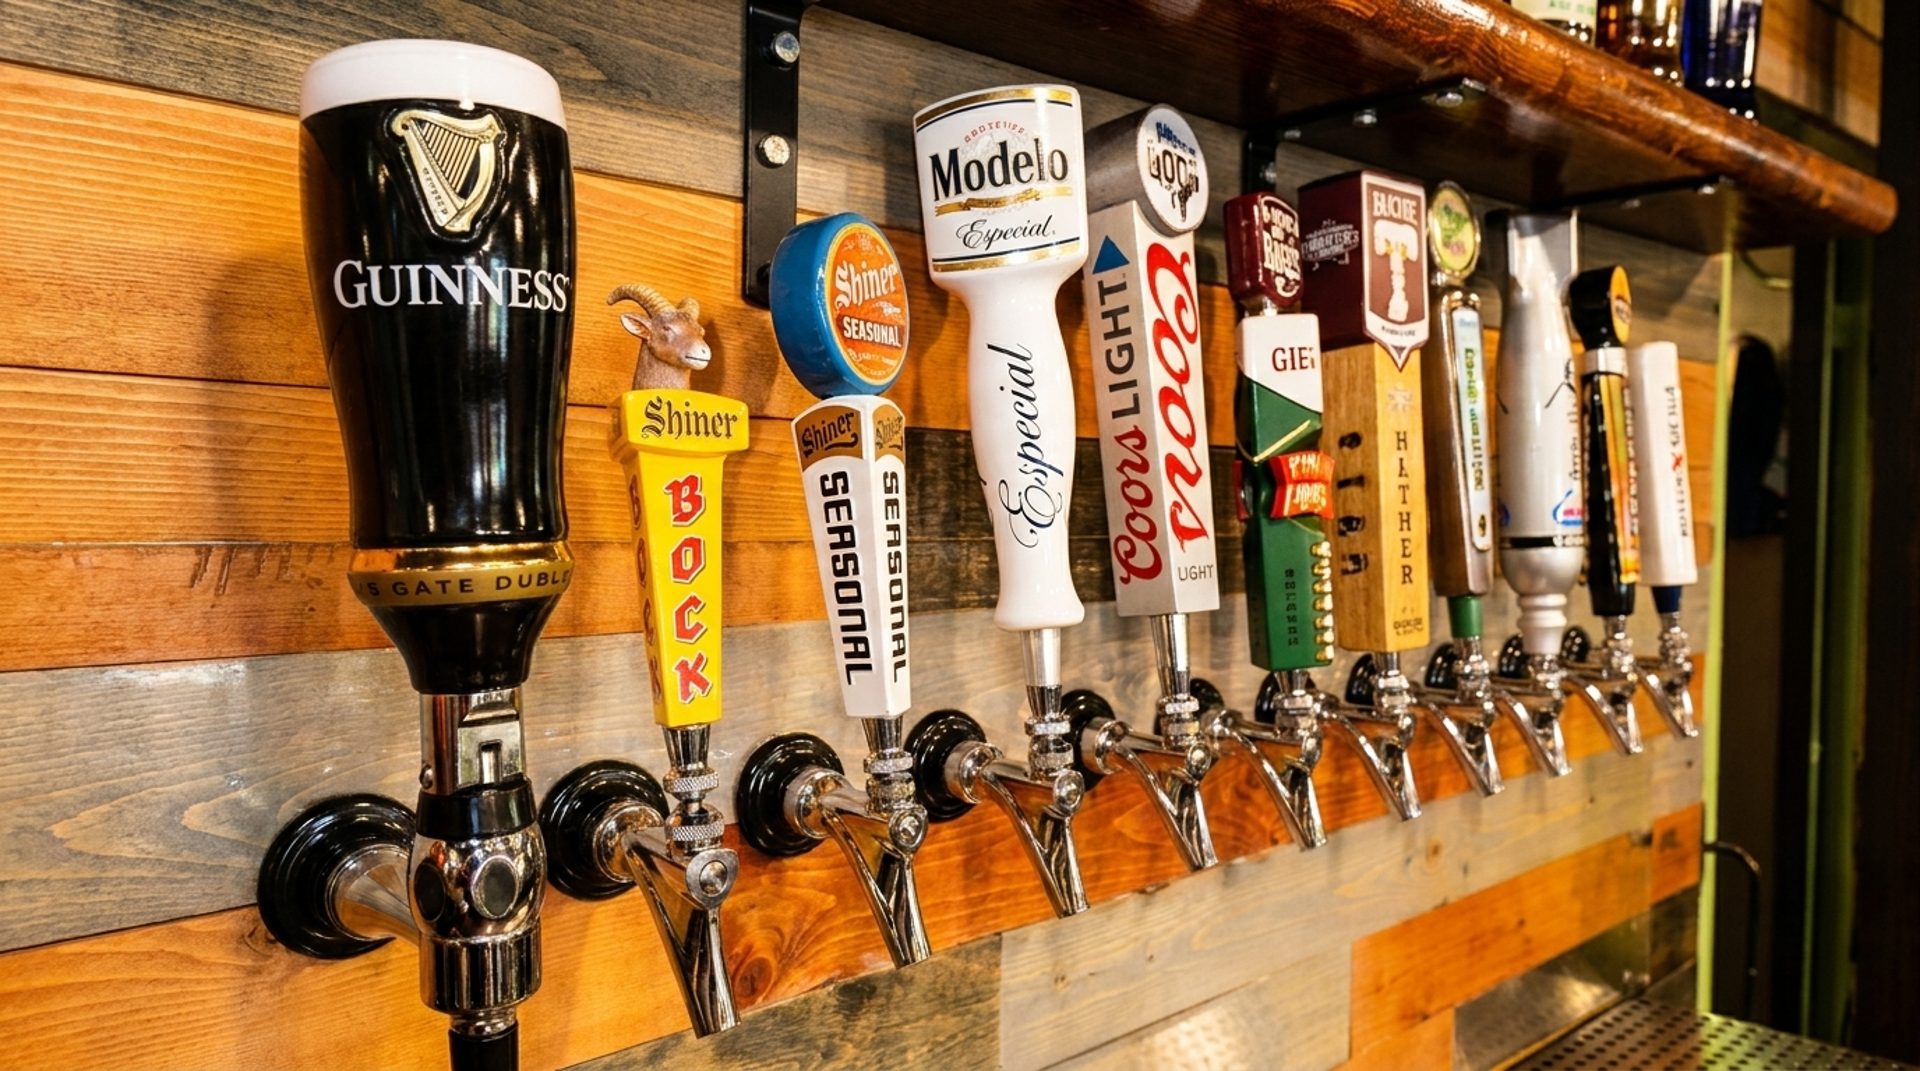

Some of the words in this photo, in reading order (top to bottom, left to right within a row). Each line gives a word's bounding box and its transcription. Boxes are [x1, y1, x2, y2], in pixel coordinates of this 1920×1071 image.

[929, 138, 1068, 202] Modelo
[956, 215, 1053, 251] Especial
[333, 260, 570, 312] GUINNESS
[834, 260, 899, 313] Shiner
[842, 315, 902, 347] SEASONAL
[1097, 279, 1140, 419] LIGHT
[641, 395, 738, 440] Shiner
[1146, 243, 1209, 552] Coors
[802, 411, 858, 458] Shiner
[986, 343, 1064, 548] Especial
[1113, 425, 1163, 585] Coors
[391, 578, 474, 597] GATE
[663, 474, 713, 705] BOCK
[819, 470, 873, 686] SEASONAL
[882, 470, 907, 684] SEASONAL
